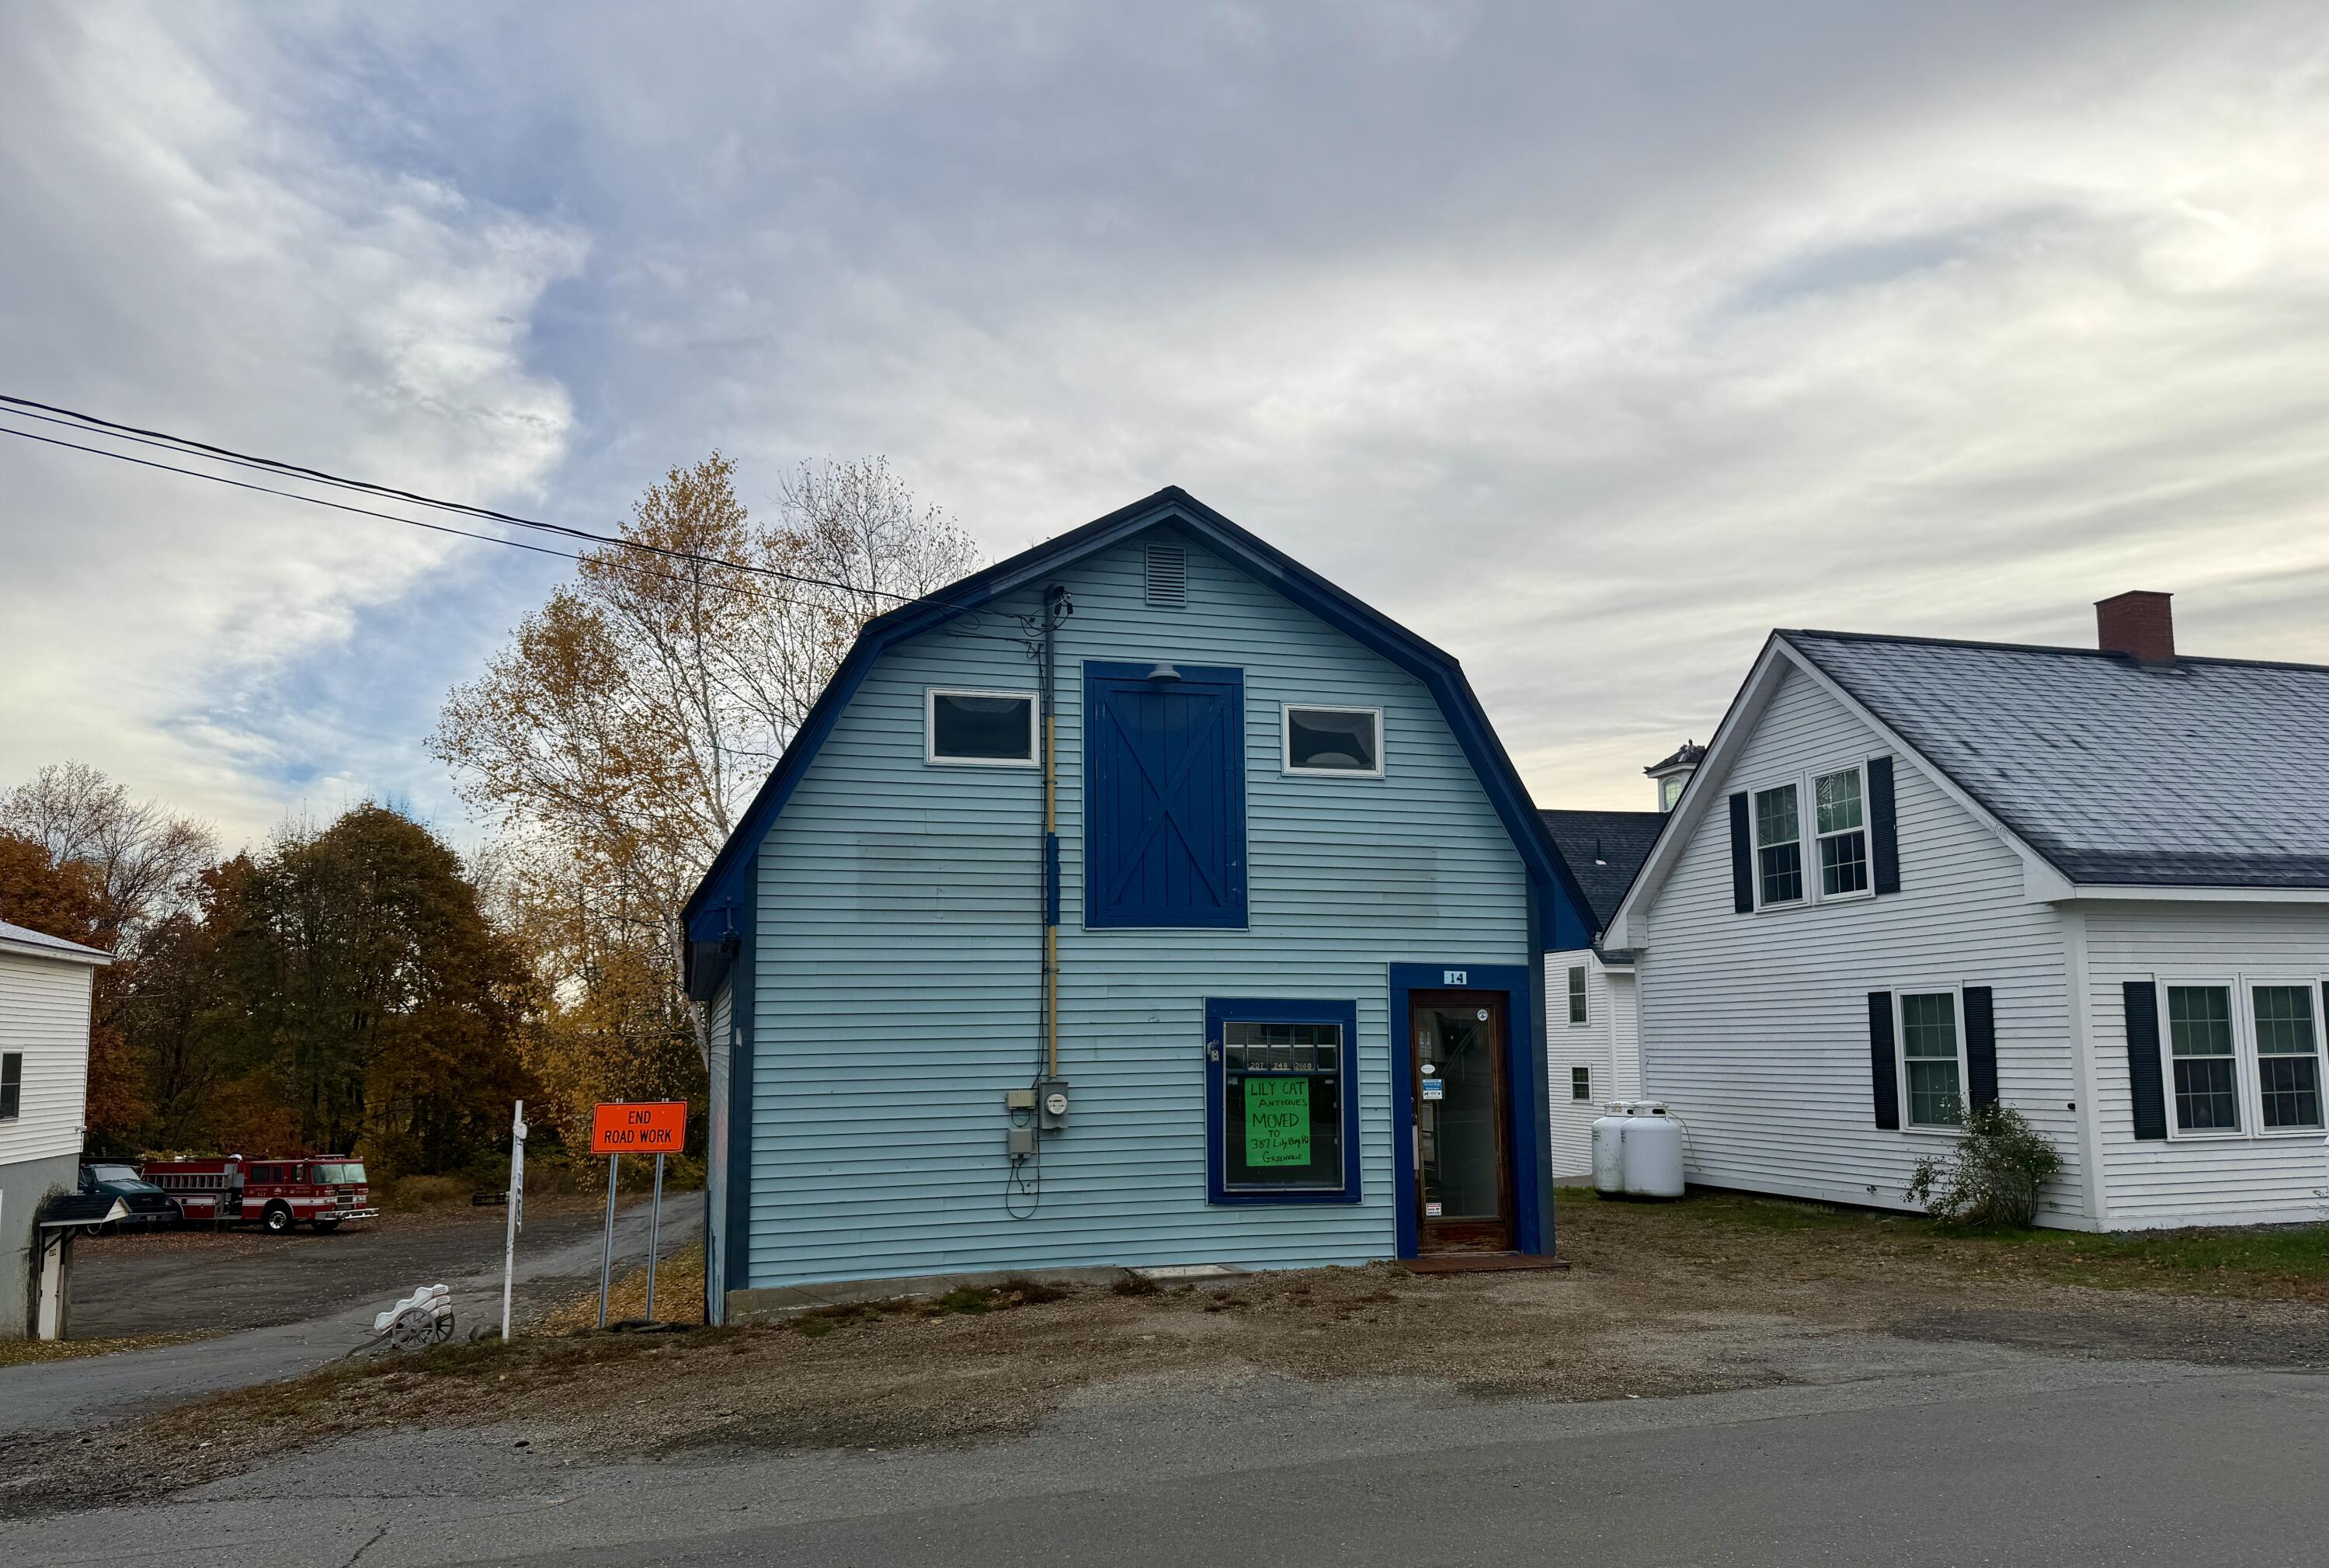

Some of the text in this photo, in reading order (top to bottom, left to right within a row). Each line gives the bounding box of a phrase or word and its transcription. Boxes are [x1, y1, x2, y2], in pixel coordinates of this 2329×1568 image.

[1451, 972, 1464, 983] 14
[1250, 1081, 1305, 1096] LILY CAT
[1258, 1099, 1308, 1108] ANTIQUES
[627, 1111, 652, 1125] END
[1252, 1112, 1299, 1128] MOVED
[604, 1129, 672, 1144] ROAD WORK
[1268, 1129, 1281, 1138] TO
[1250, 1138, 1271, 1149] 387
